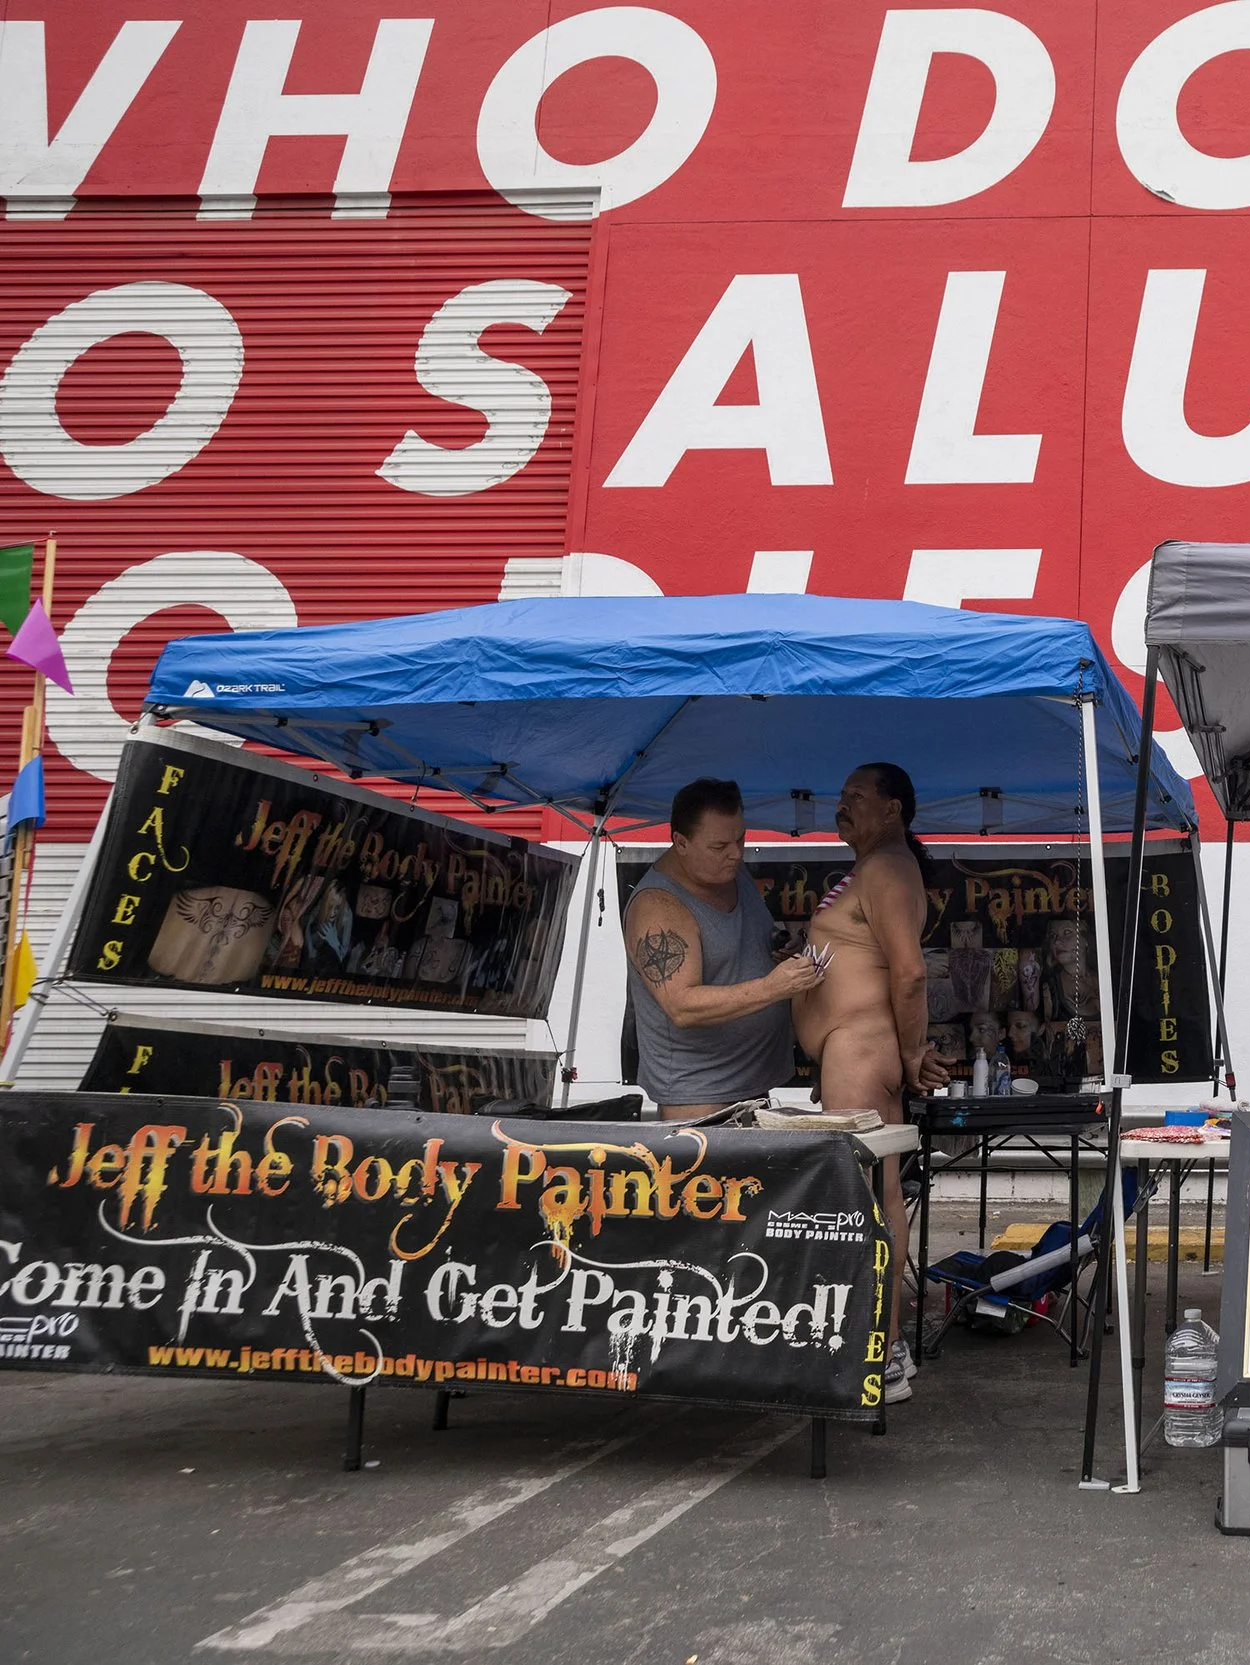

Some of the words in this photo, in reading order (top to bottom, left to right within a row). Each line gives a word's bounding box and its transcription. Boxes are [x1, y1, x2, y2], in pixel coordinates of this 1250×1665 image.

[97, 764, 190, 971] FACES
[235, 800, 322, 890] Jeff
[315, 800, 368, 870] the
[359, 832, 440, 923] Body
[1150, 873, 1180, 1075] BODIES
[47, 1122, 195, 1234] Jeff
[190, 1102, 311, 1197] the
[311, 1135, 482, 1261] Body
[491, 1120, 765, 1269] Painter
[765, 1227, 803, 1239] BODY
[805, 1229, 864, 1242] PAINTER
[148, 1344, 638, 1392] www.jeffthebodypainter.com
[423, 1240, 572, 1331] Get
[561, 1245, 853, 1392] Painted!
